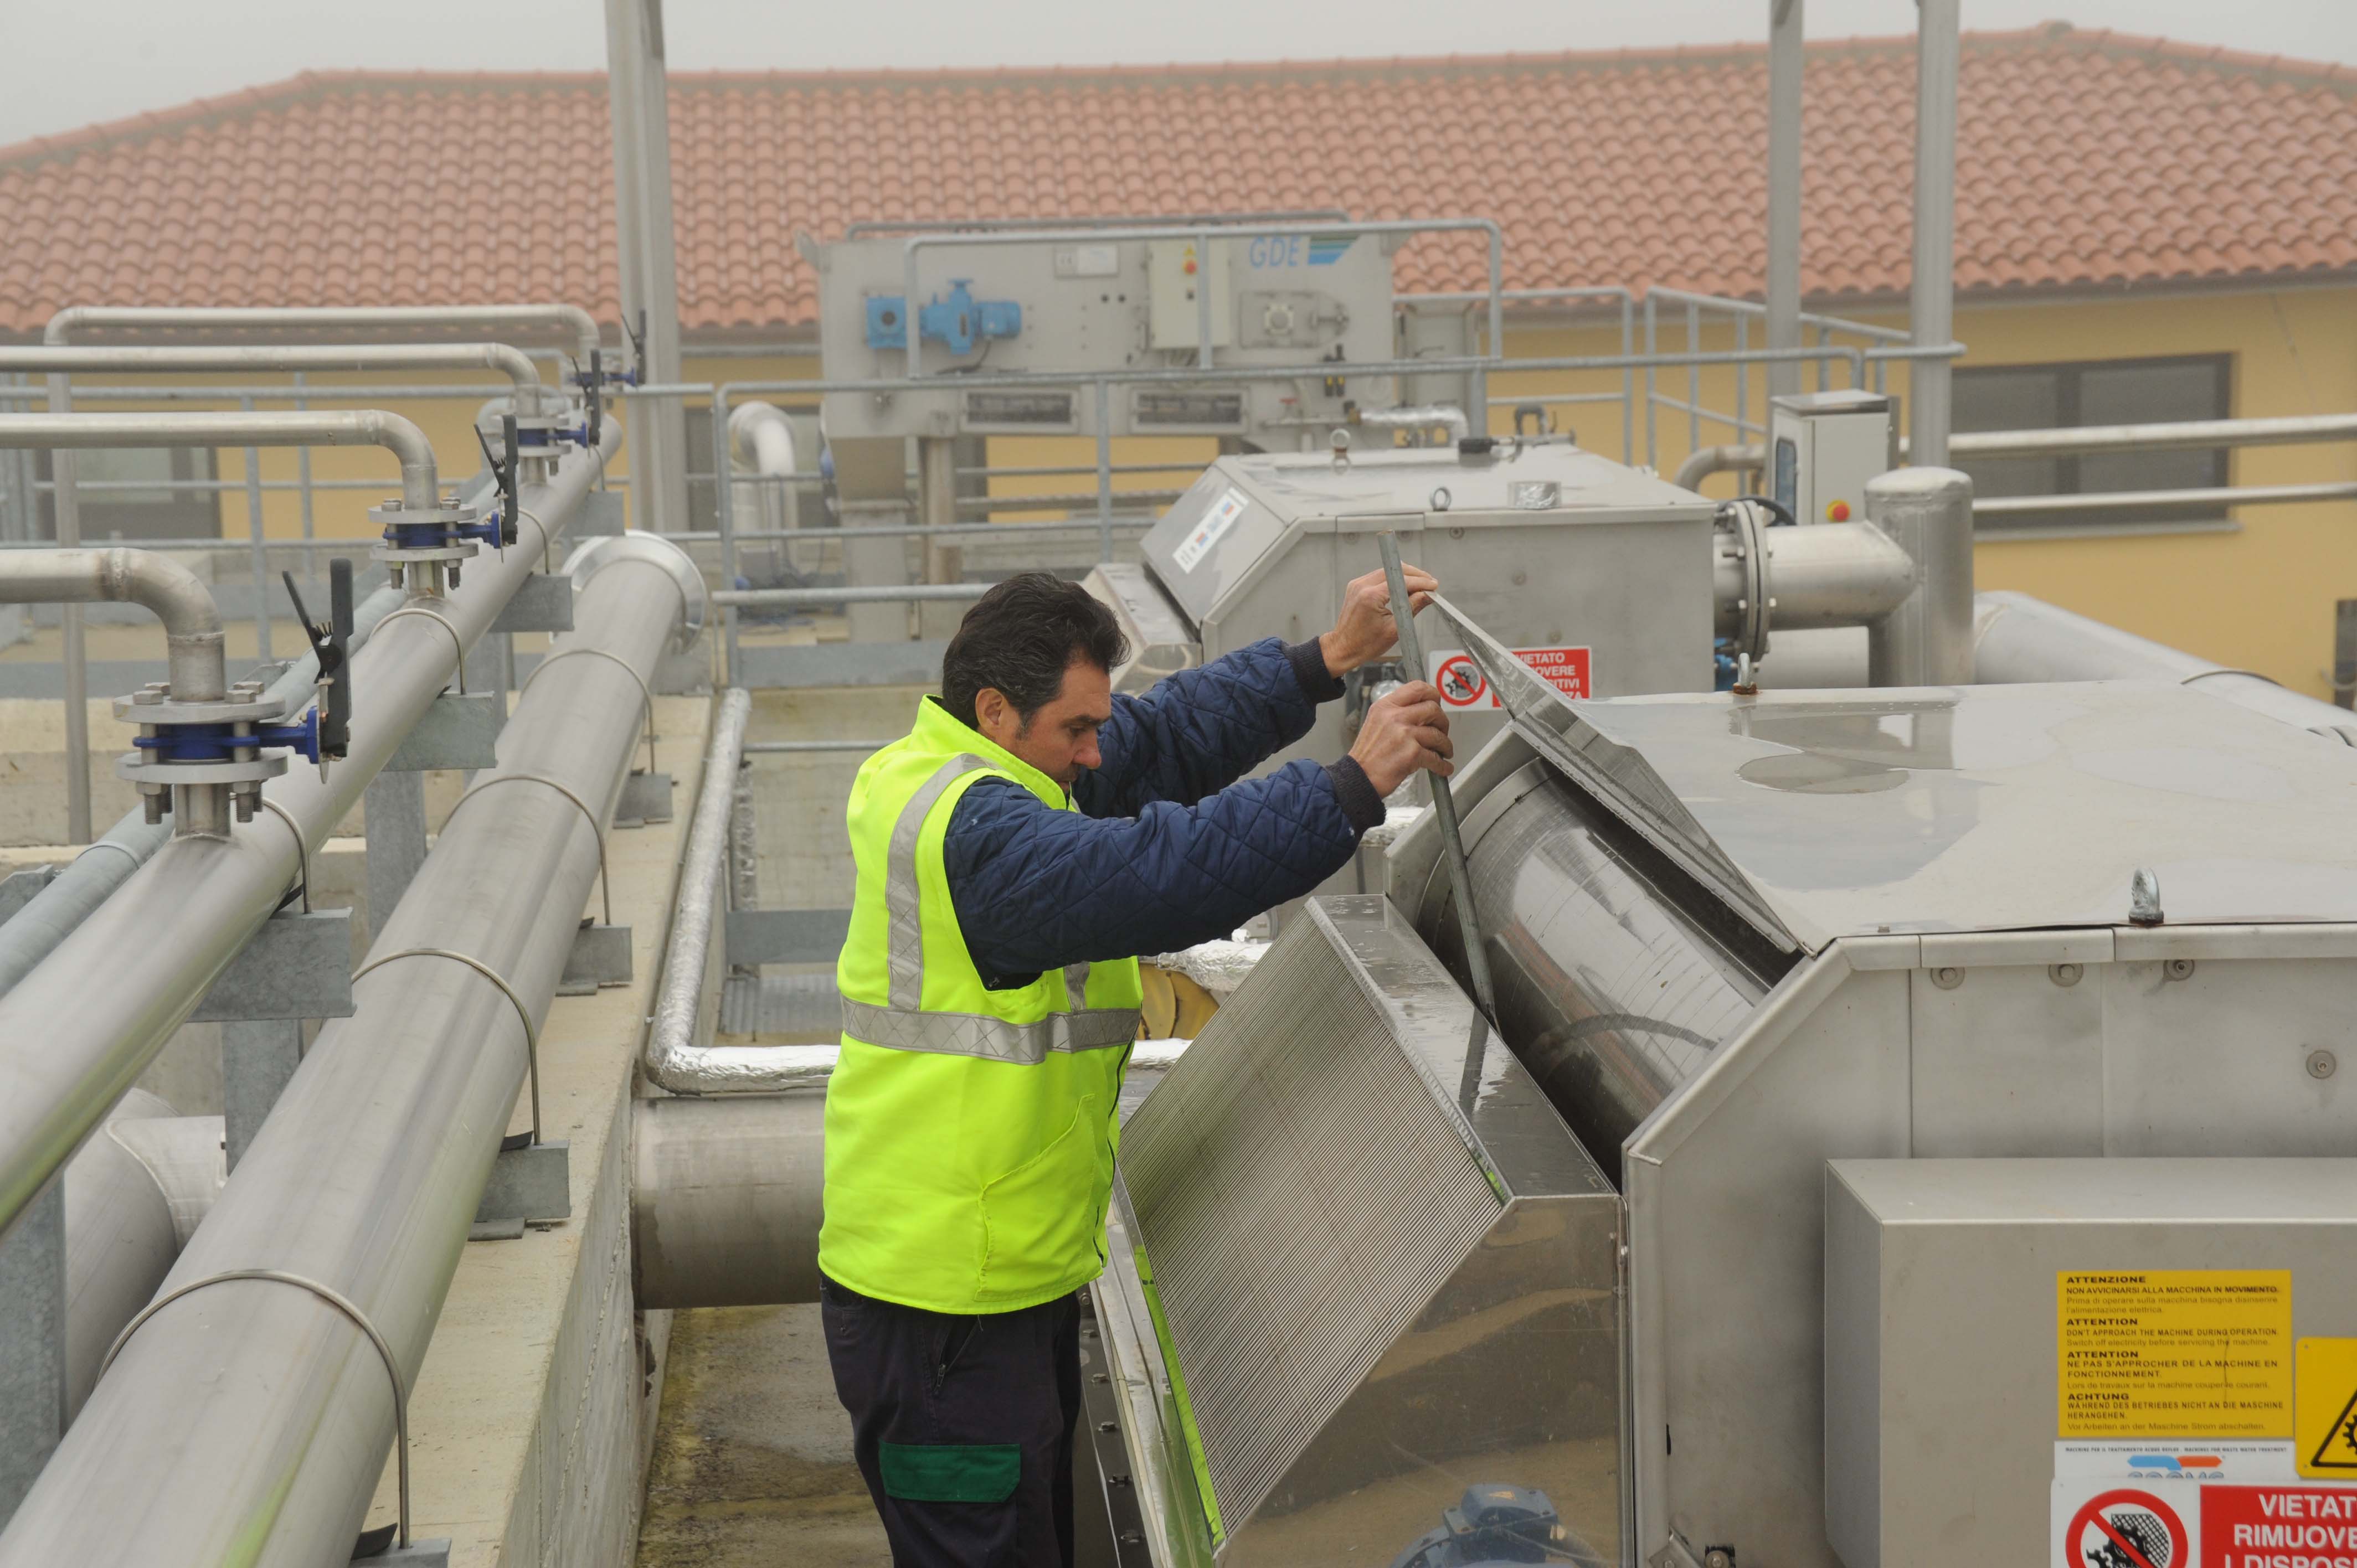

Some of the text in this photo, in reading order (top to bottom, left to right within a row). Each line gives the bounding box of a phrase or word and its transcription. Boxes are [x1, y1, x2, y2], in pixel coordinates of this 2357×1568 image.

[1249, 235, 1302, 269] GDE
[1533, 665, 1576, 677] OVERE
[2258, 1493, 2357, 1518] VIETAT
[2234, 1524, 2357, 1549] RIMUOVE
